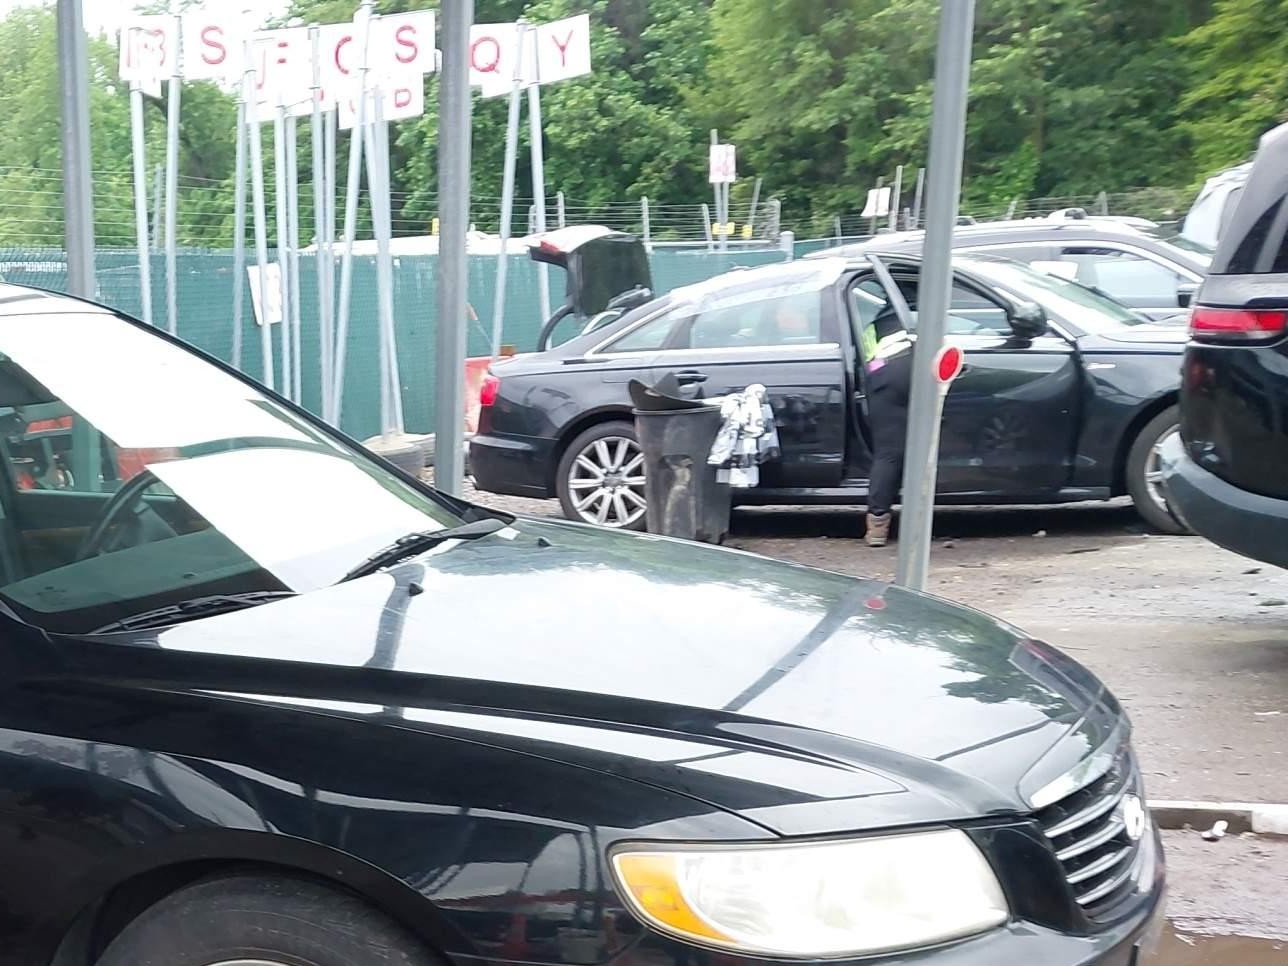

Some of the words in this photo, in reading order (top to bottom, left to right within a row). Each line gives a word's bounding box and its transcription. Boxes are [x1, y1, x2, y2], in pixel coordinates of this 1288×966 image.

[200, 25, 227, 65] S
[395, 25, 418, 64] S
[469, 36, 500, 74] Q
[551, 29, 574, 67] Y
